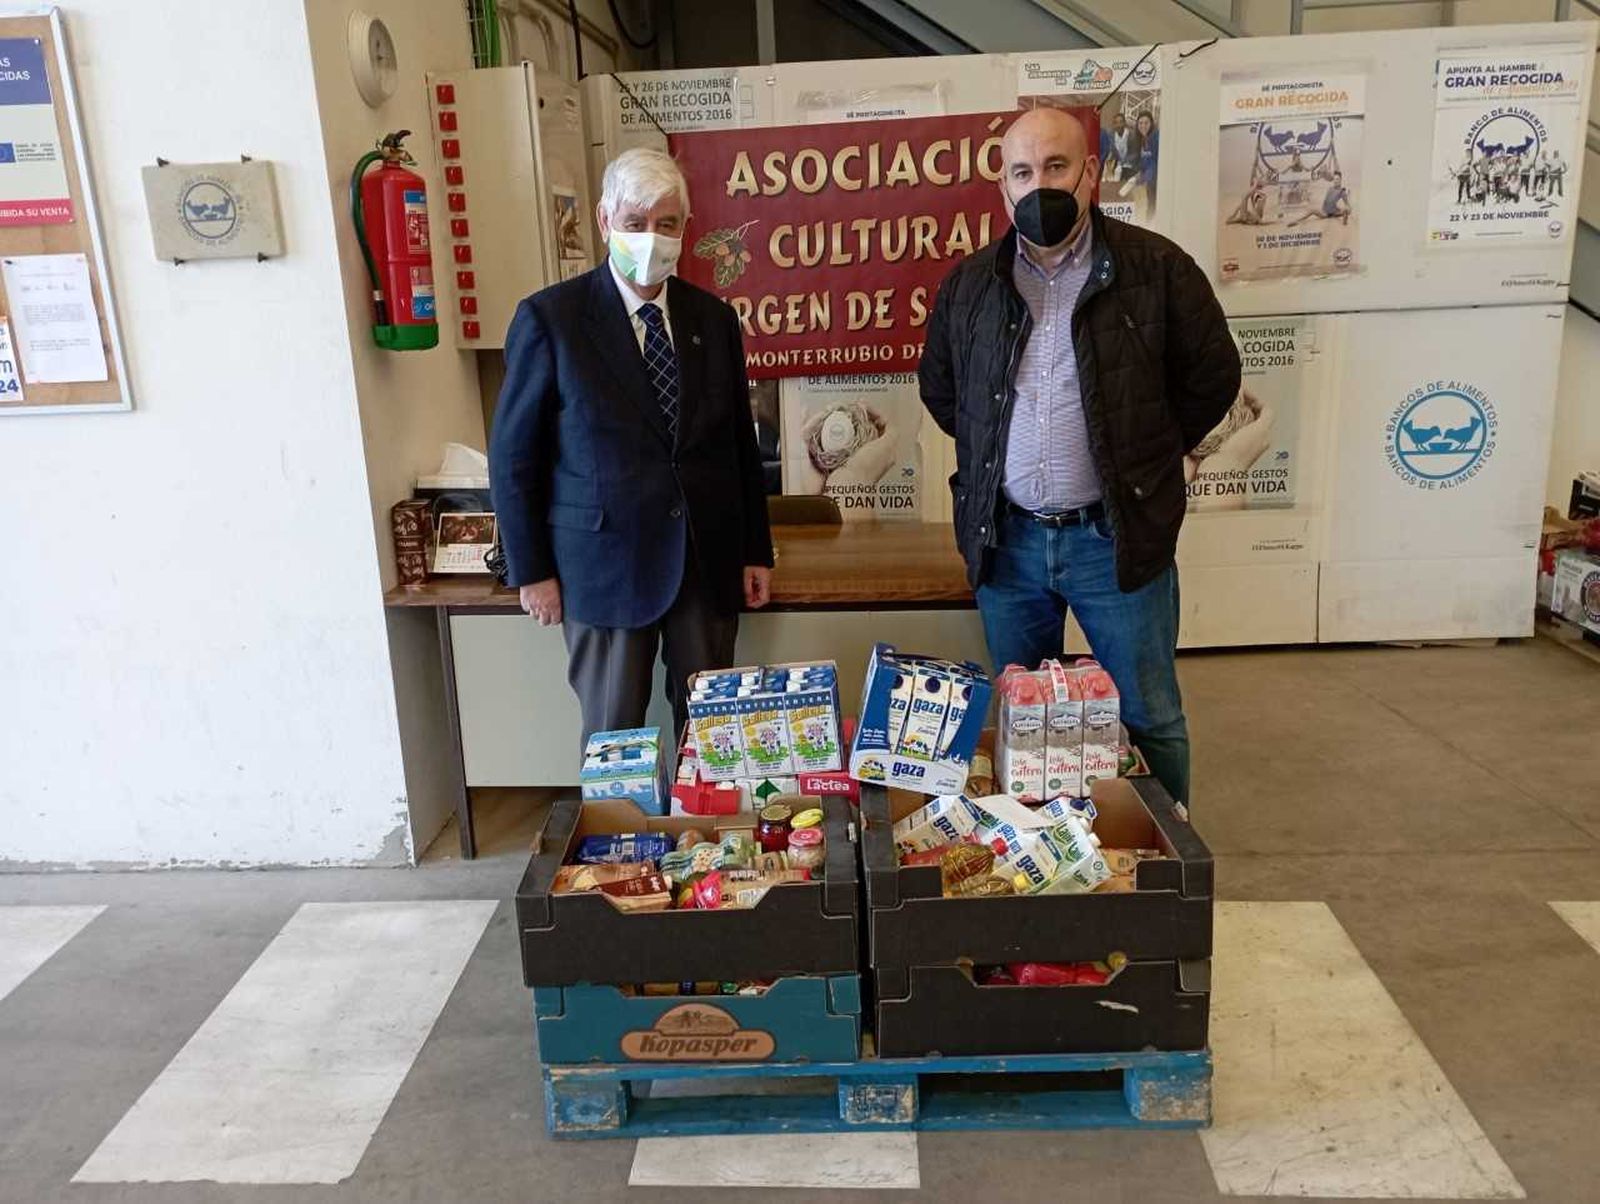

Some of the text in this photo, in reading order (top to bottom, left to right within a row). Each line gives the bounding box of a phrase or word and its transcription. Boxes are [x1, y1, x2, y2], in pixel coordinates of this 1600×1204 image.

[657, 81, 668, 92] DE
[671, 78, 731, 91] NOVIEMBRE
[1445, 75, 1485, 88] GRAN
[1490, 72, 1564, 86] RECOGIDA
[620, 91, 731, 110] GRAN RECOGIDA
[621, 108, 732, 125] DE ALIMENTOS 2016
[1464, 106, 1548, 145] BANCO DE ALIMENTOS
[726, 118, 1003, 198] ASOCIACIÓ
[726, 285, 929, 337] RGEN DE S
[1238, 328, 1295, 339] NOVIEMBRE
[1243, 340, 1295, 353] COGIDA
[745, 344, 894, 368] MONTERRUBIO
[1268, 355, 1294, 366] 2016
[825, 374, 886, 385] ALIMENTOS
[889, 373, 915, 385] 2016
[1386, 380, 1498, 432] BANCOS DE ALIMENTOS
[1385, 440, 1496, 490] BANCOS DE ALIMENTOS
[1197, 468, 1288, 481] PEQUEÑOS GESTOS
[825, 483, 915, 495] PEQUEÑOS GESTOS
[1216, 482, 1247, 496] DAN
[1252, 480, 1287, 494] VIDA
[845, 496, 875, 509] DAN
[880, 496, 914, 508] VIDA
[891, 698, 907, 711] za
[912, 698, 944, 713] gaza
[891, 762, 926, 777] gaza
[1016, 854, 1045, 884] gaza
[639, 1035, 758, 1057] Kopasper
